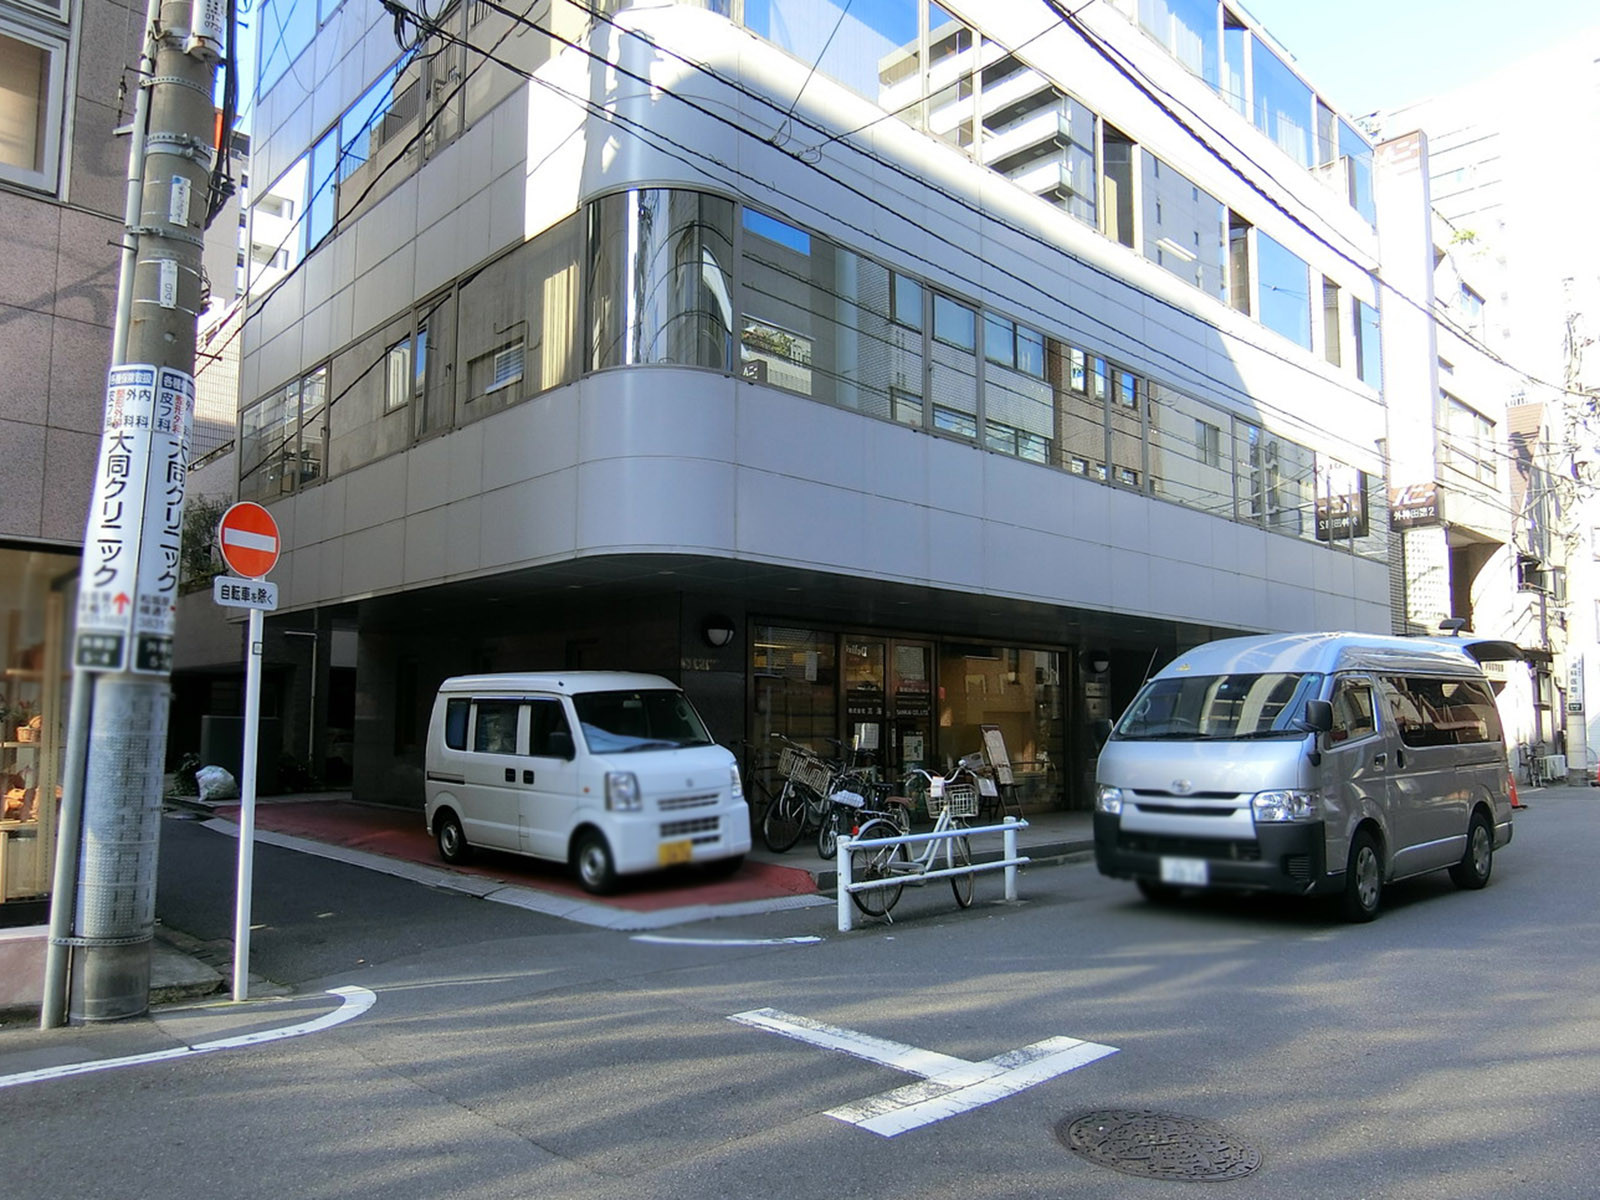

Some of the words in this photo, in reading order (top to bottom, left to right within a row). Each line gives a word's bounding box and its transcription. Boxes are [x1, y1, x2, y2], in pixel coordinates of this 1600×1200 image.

[158, 392, 174, 432] 皮フ科
[94, 431, 134, 587] 大同クリニック
[158, 441, 188, 592] 大同クリニック
[221, 584, 273, 605] 自転車を除く
